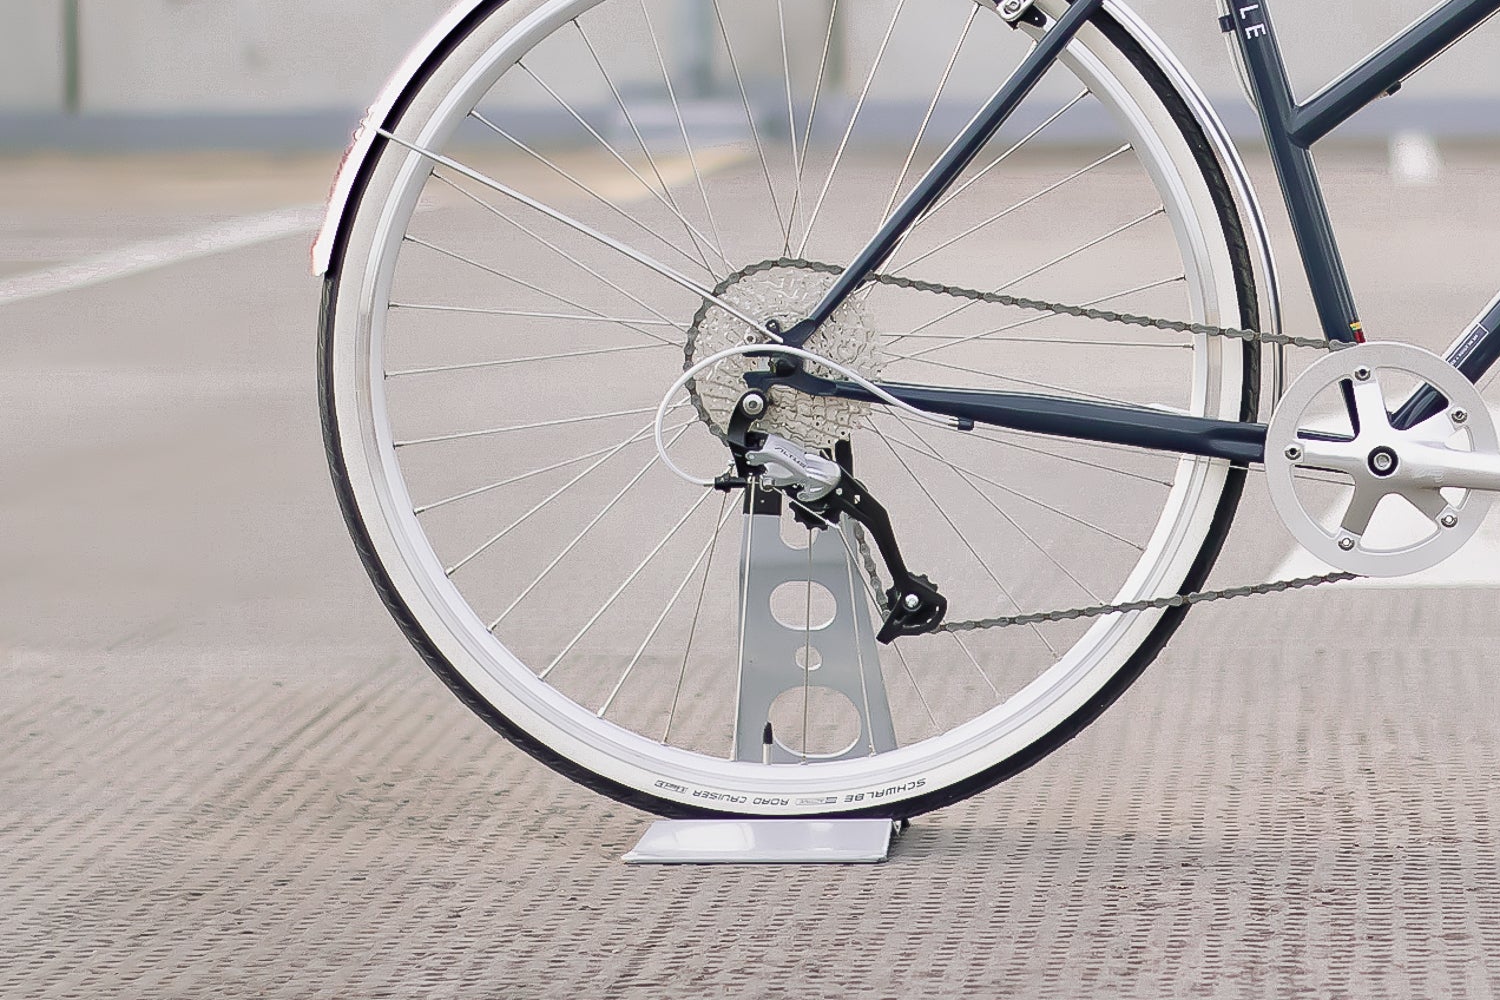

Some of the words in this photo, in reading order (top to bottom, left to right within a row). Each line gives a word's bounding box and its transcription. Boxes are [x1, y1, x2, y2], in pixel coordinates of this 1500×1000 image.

[692, 789, 748, 804] CRUISER
[843, 777, 927, 803] SCHWALBE
[752, 797, 790, 806] ROAD
